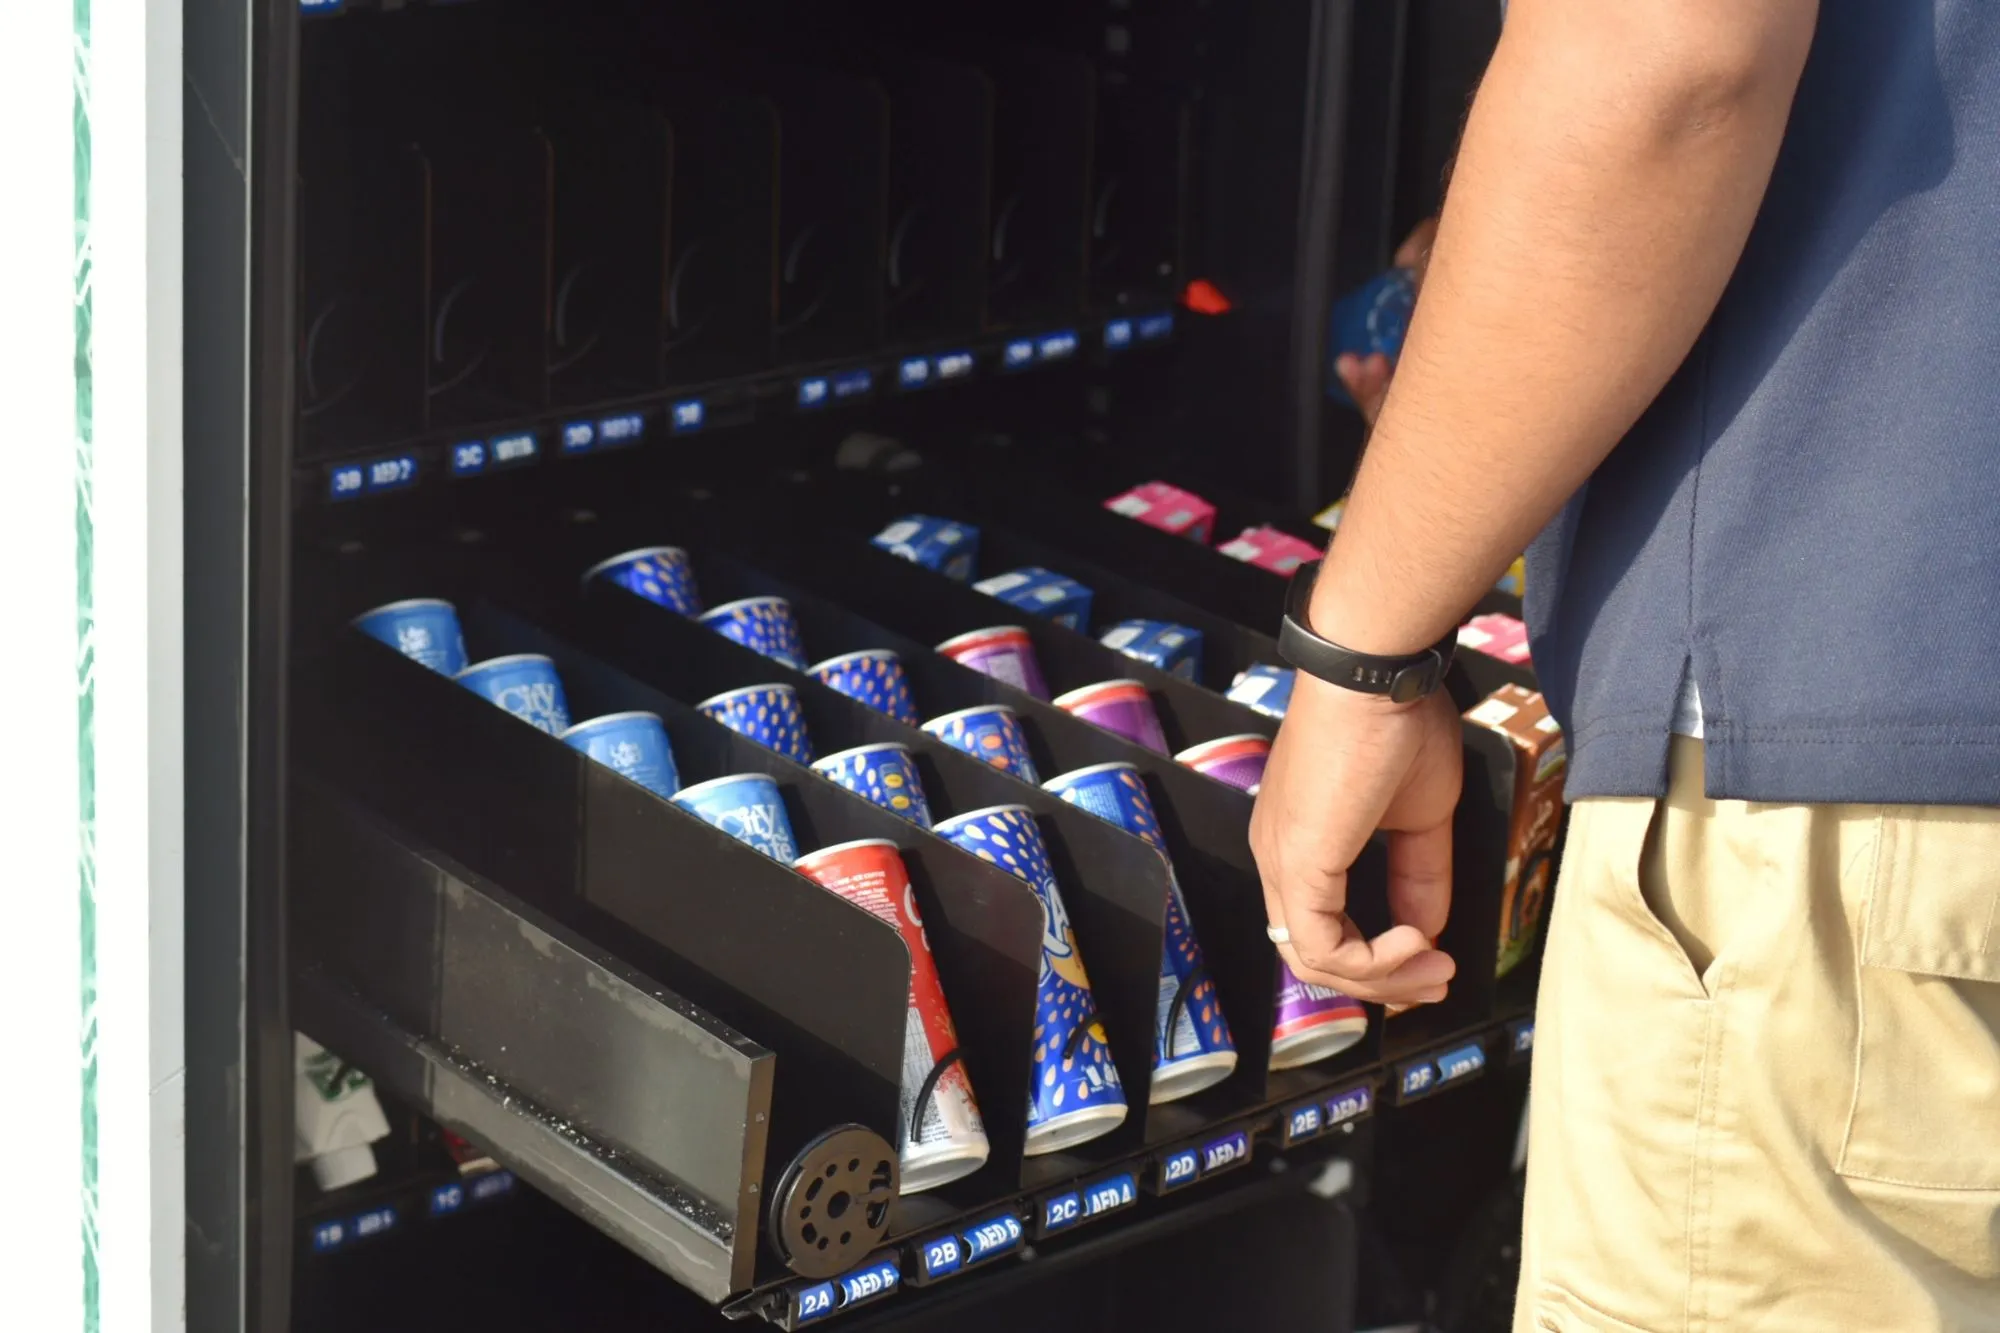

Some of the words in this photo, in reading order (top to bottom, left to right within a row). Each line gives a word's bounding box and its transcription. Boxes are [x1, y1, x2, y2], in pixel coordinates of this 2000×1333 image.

[715, 803, 777, 840] City
[1408, 1065, 1433, 1090] 2F
[1294, 1109, 1318, 1133] 2E
[1170, 1155, 1195, 1179] 2D
[1052, 1199, 1078, 1224] 2C
[932, 1242, 958, 1268] 2B
[974, 1223, 1008, 1251] AED
[1005, 1218, 1019, 1239] 6
[804, 1290, 830, 1314] 2A
[850, 1273, 882, 1300] AED
[882, 1268, 894, 1287] 6
